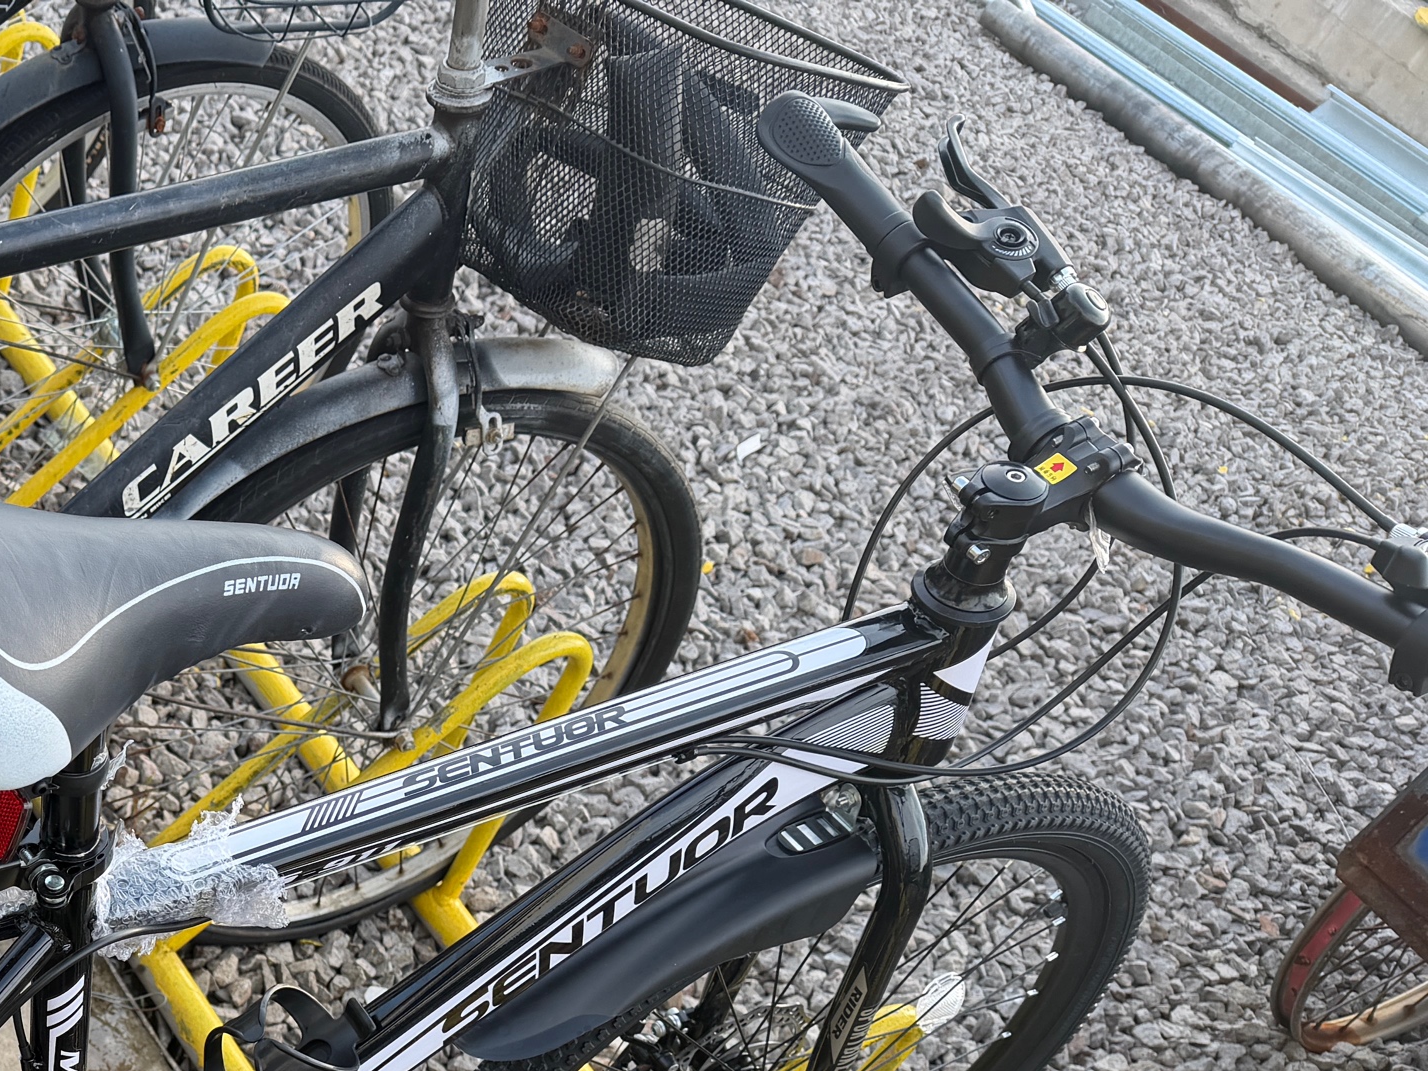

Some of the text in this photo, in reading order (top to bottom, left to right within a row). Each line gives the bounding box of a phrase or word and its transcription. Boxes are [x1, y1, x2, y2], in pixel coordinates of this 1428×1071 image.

[122, 281, 383, 517] CAREER
[403, 706, 626, 797] SENTUOR
[441, 777, 779, 1046] SENTUOR
[832, 986, 862, 1039] RIDER
